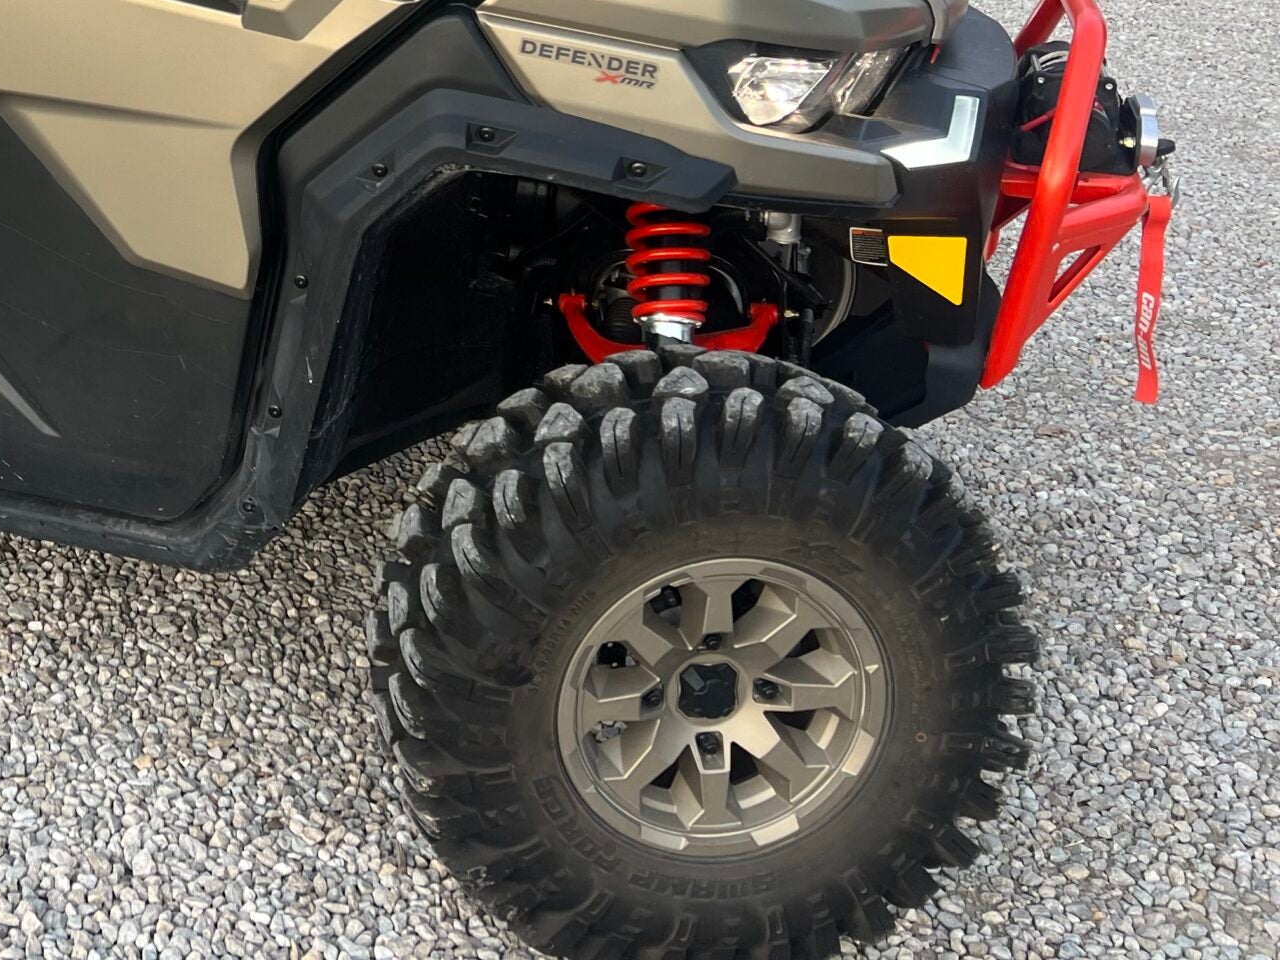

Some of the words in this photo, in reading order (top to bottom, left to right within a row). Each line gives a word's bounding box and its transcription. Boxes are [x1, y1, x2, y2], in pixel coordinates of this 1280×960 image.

[520, 39, 659, 79] DEFENDER
[531, 774, 624, 874] FORCE
[627, 870, 777, 899] SWAMP
